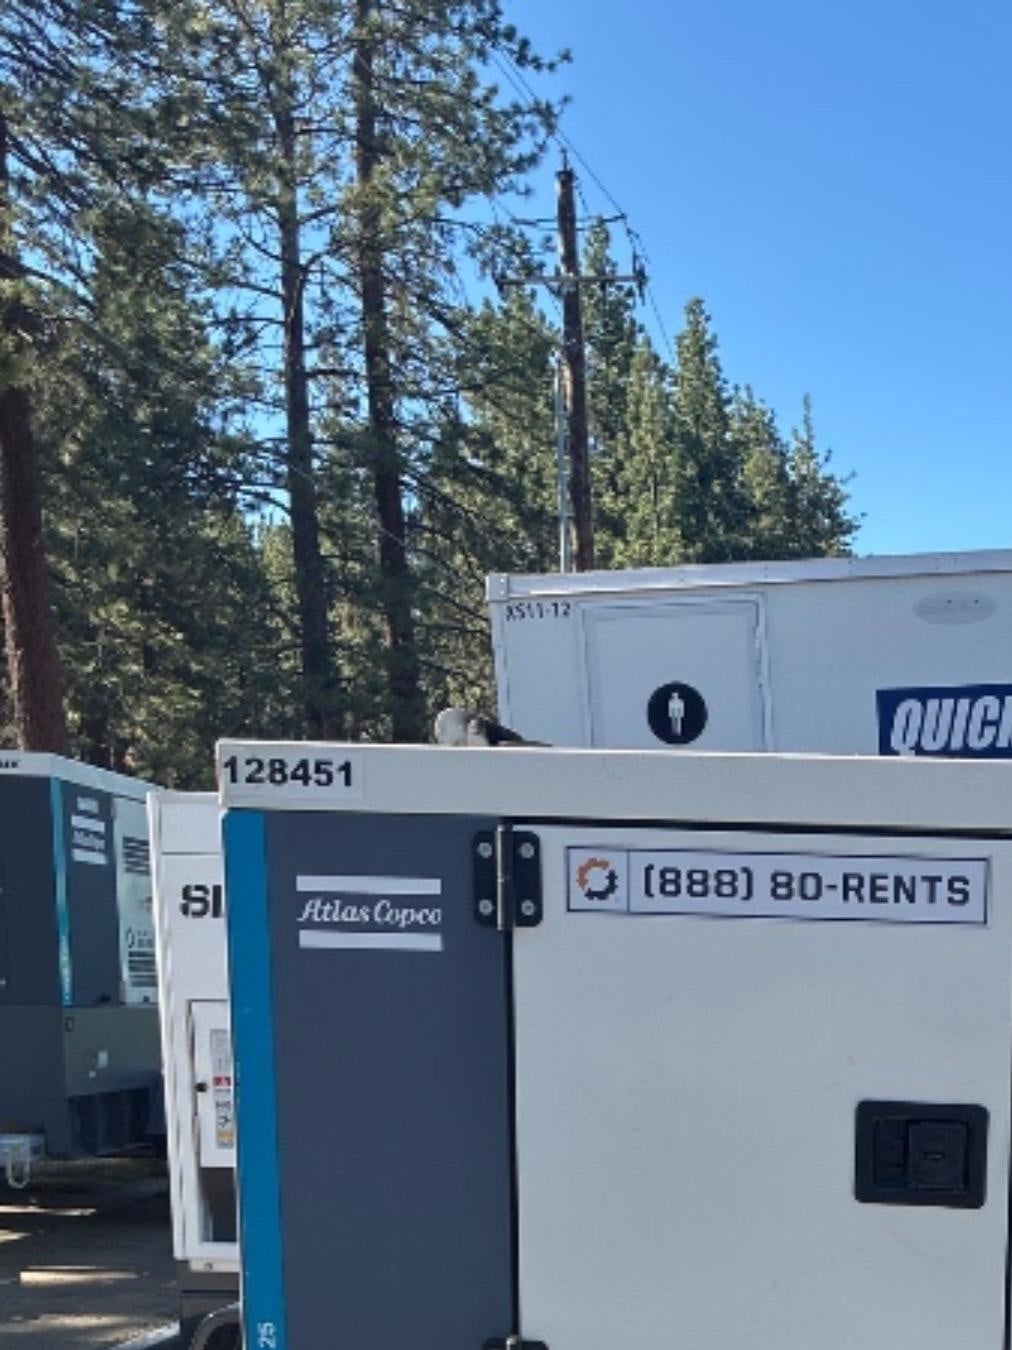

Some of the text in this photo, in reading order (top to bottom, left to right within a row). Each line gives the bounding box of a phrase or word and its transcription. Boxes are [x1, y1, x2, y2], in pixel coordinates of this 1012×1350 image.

[223, 755, 353, 787] 128451
[643, 863, 971, 907] (888) 80-RENTS
[296, 897, 443, 929] Atlas Copco
[257, 1321, 277, 1348] 25
